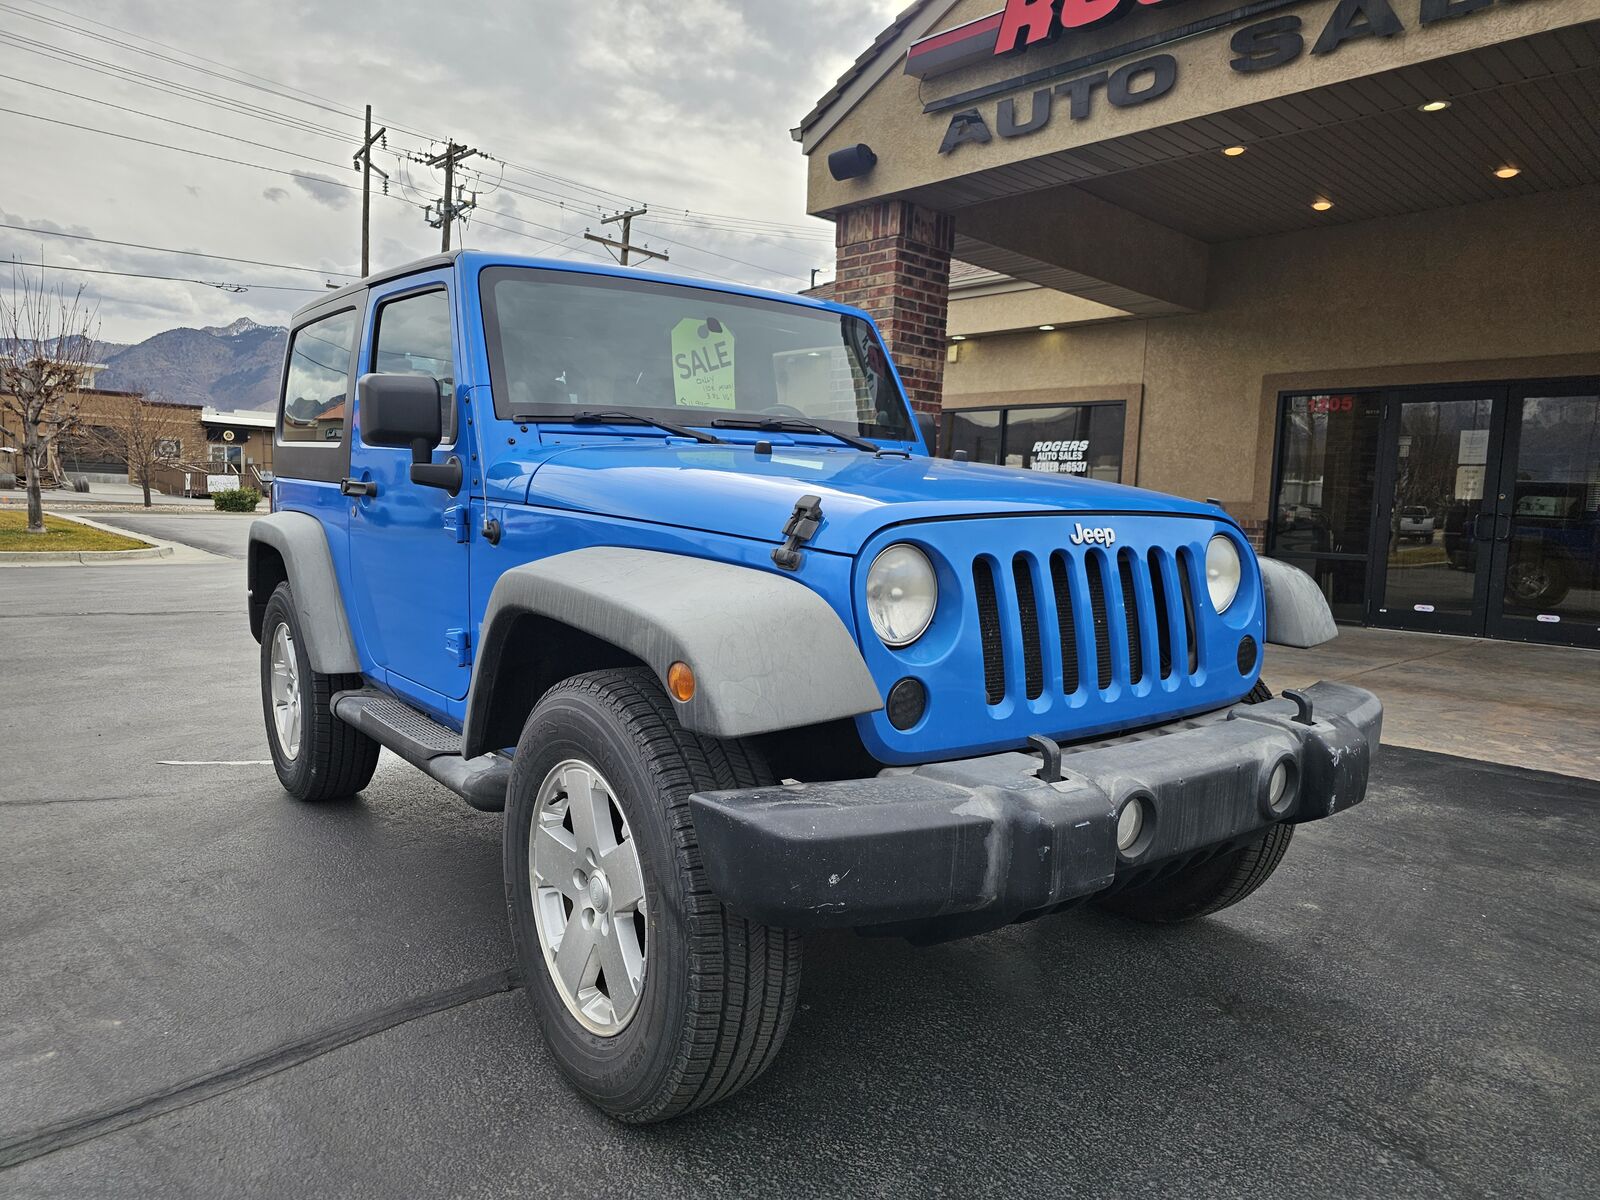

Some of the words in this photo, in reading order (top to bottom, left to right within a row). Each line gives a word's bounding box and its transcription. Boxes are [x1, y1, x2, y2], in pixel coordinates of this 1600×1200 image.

[938, 54, 1177, 155] AUTO
[674, 341, 732, 379] SALE
[1032, 440, 1090, 452] ROGERS
[1037, 452, 1057, 461] AUTO
[1058, 452, 1083, 461] SALES
[1060, 461, 1087, 473] #6537
[1070, 522, 1116, 548] Jeep
